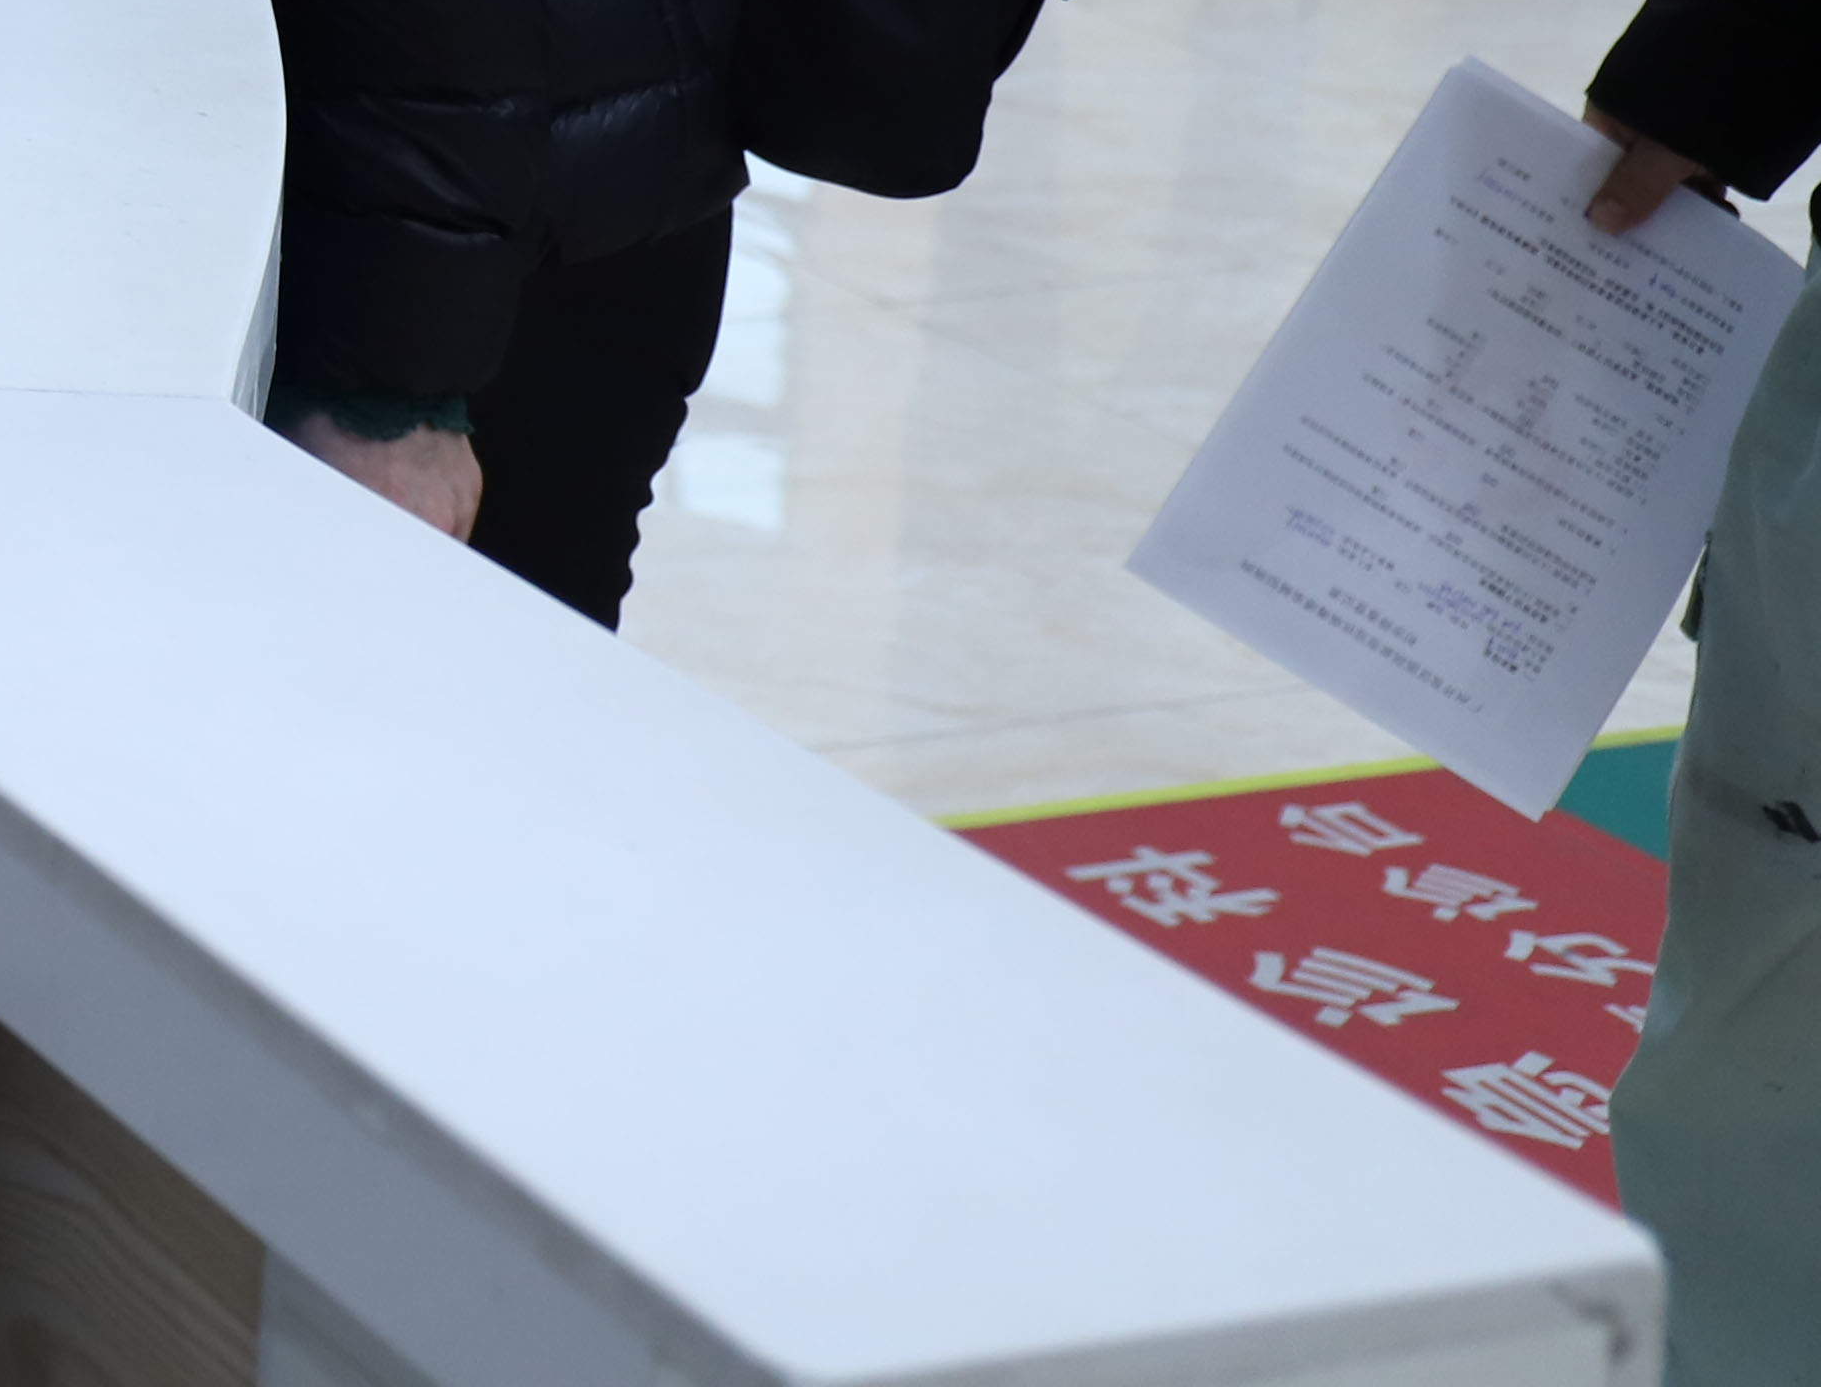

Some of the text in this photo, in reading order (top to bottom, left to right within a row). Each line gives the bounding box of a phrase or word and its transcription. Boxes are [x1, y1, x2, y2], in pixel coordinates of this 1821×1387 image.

[1065, 846, 1611, 1149] 急诊科
[1278, 801, 1656, 1032] 分诊台
